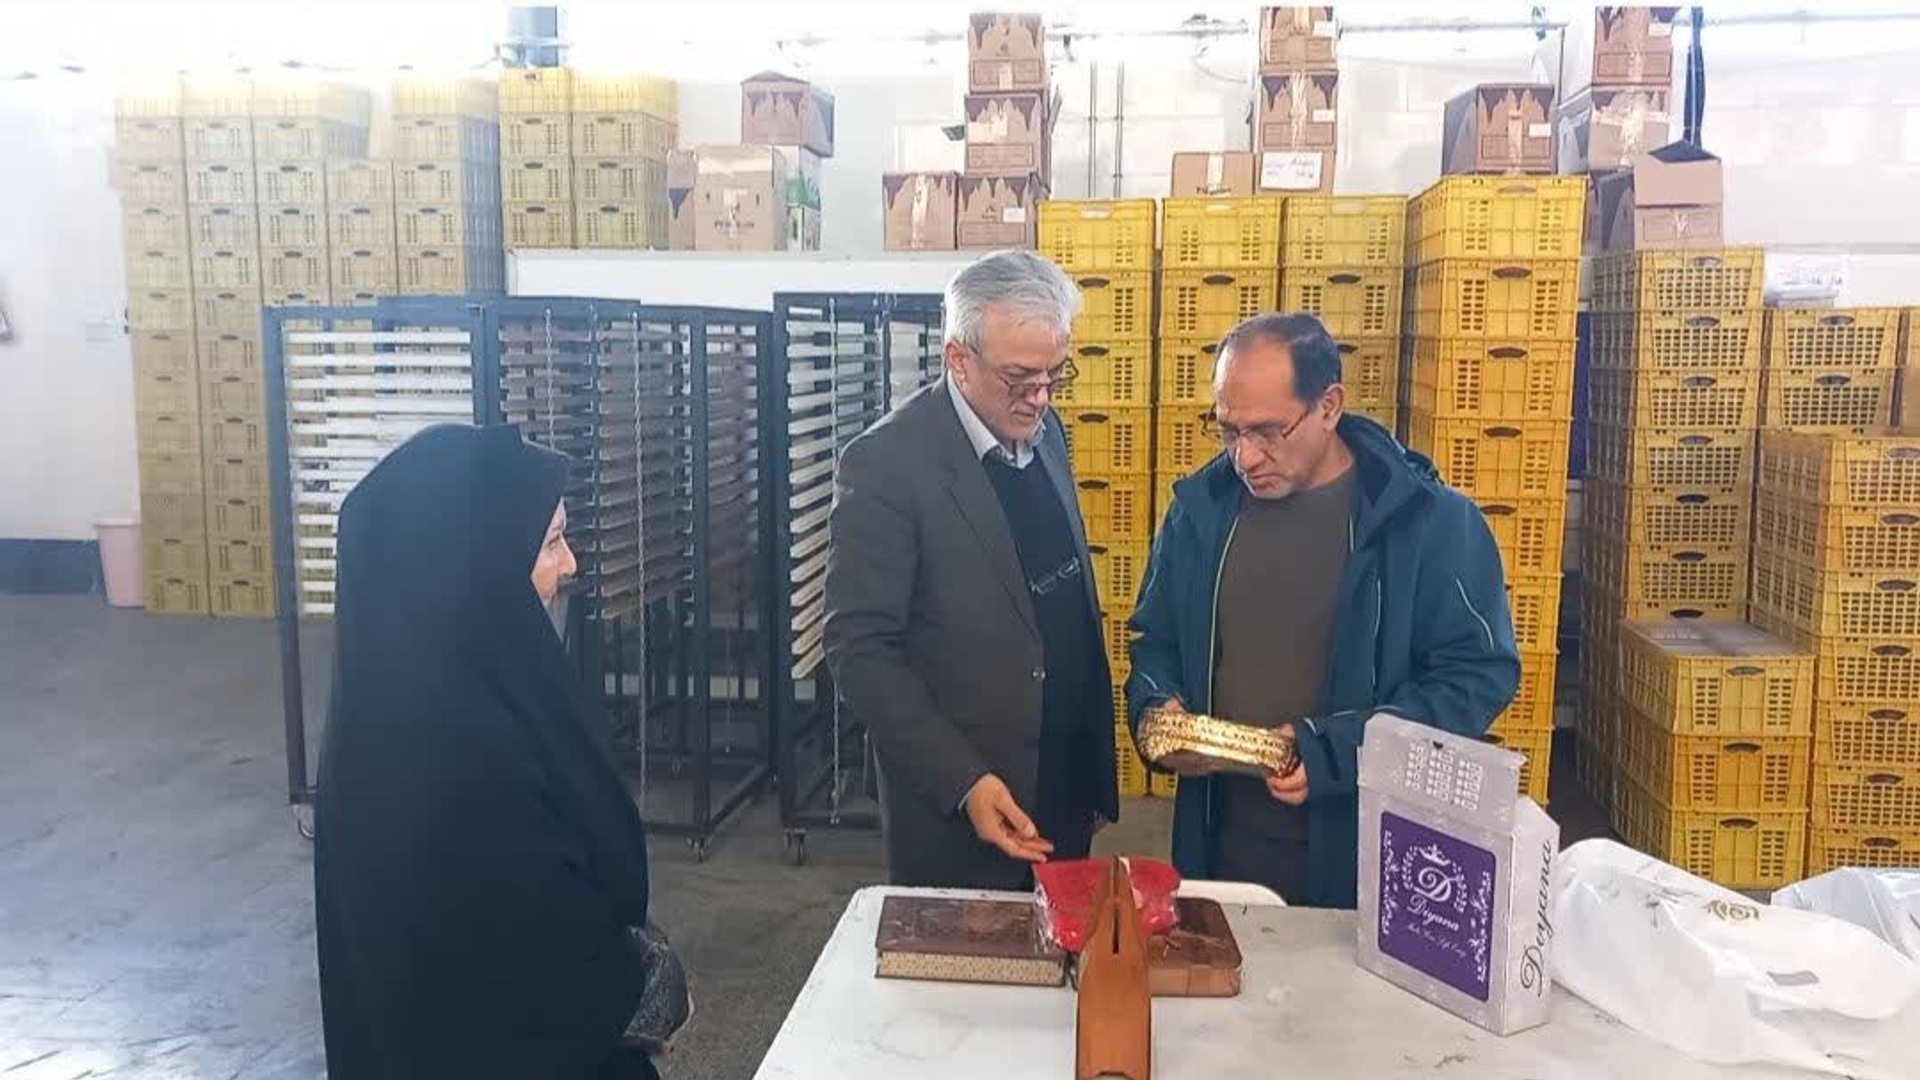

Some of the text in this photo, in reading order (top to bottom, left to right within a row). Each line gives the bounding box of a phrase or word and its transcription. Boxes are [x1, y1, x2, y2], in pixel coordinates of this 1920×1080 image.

[1413, 866, 1459, 902] D
[1406, 894, 1460, 932] Diyana
[1520, 839, 1555, 998] Diyana
